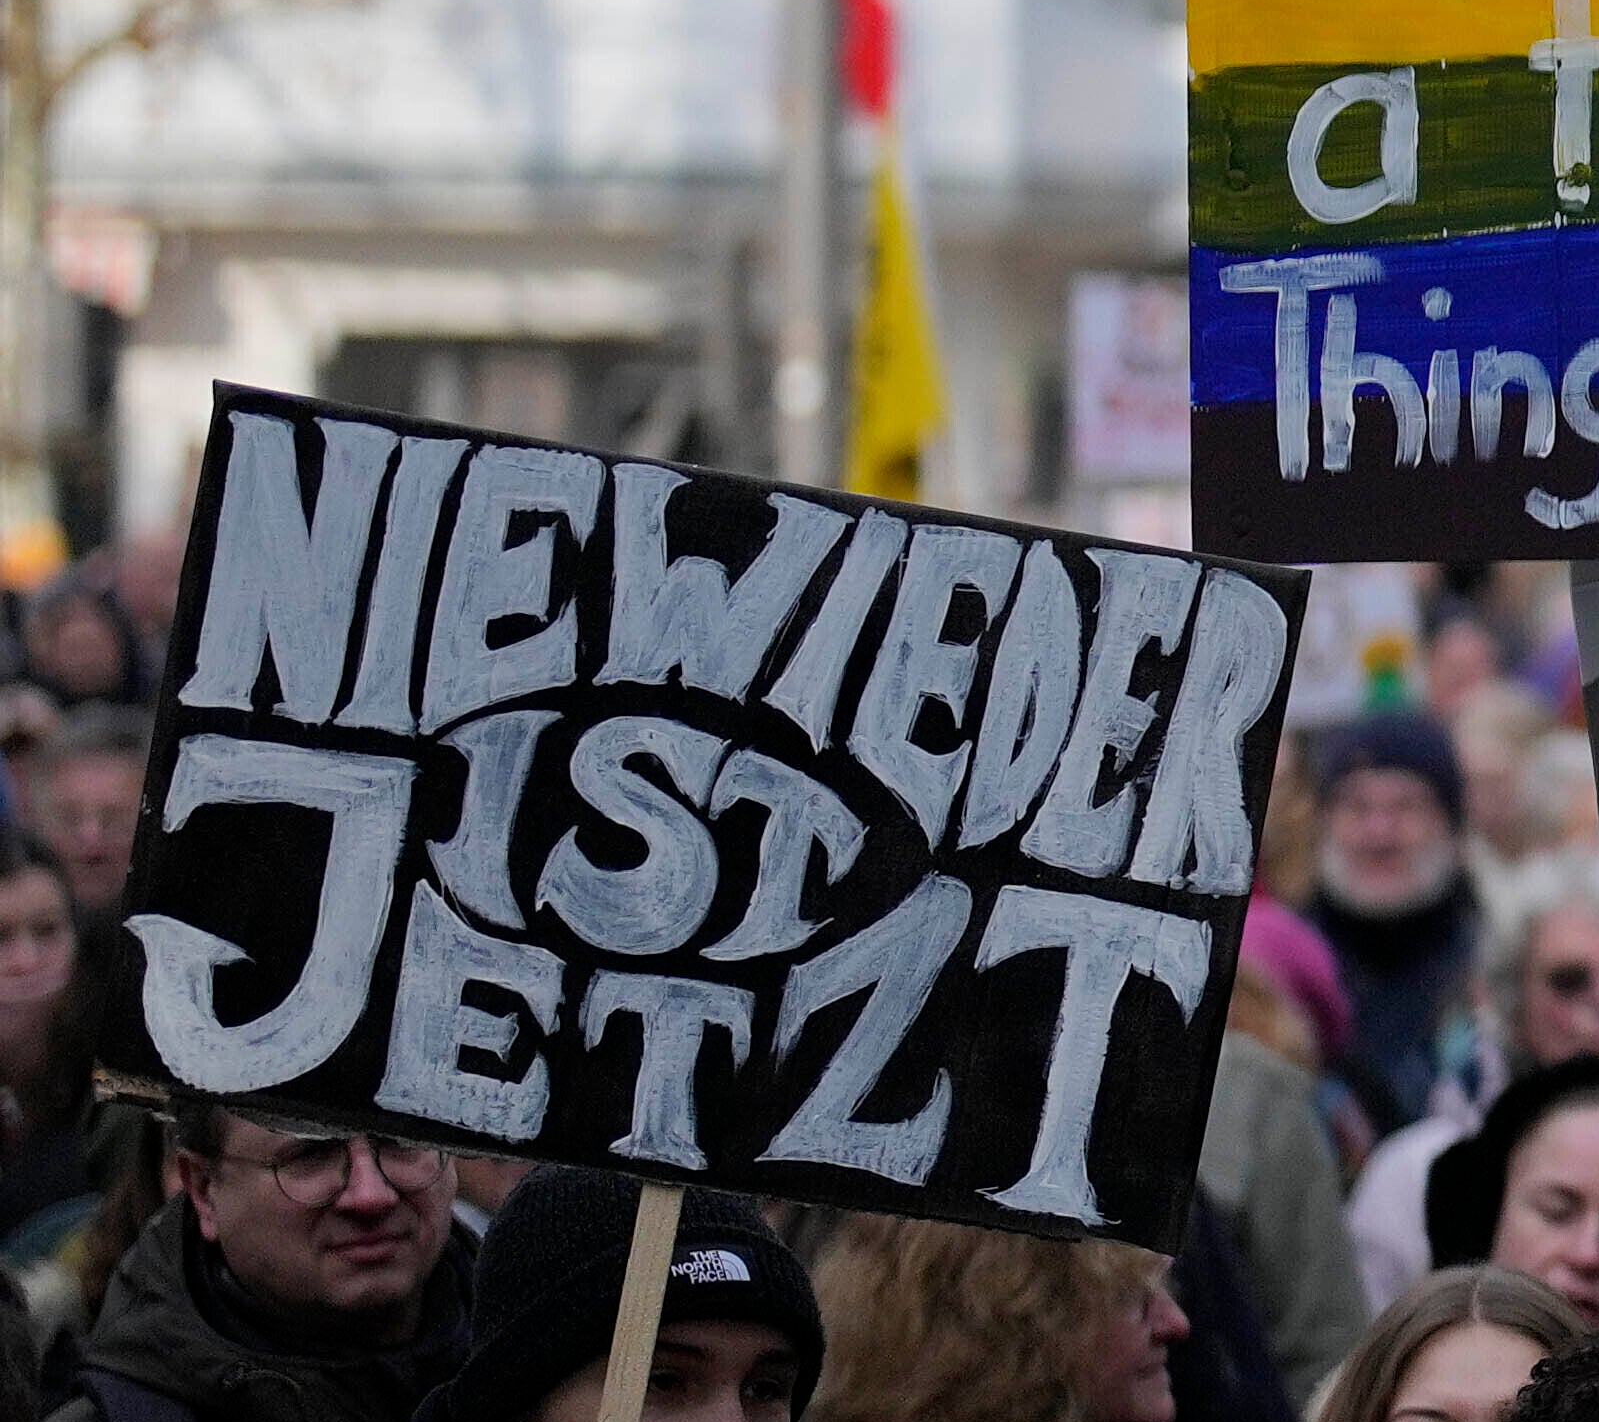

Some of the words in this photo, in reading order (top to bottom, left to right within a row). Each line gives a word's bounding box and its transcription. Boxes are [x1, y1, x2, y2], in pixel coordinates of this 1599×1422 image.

[1287, 67, 1420, 224] a
[424, 710, 872, 961] IST
[125, 735, 1214, 1225] JETZT
[671, 1258, 723, 1277] NORTH
[689, 1250, 720, 1263] THE
[689, 1270, 727, 1285] FACE
